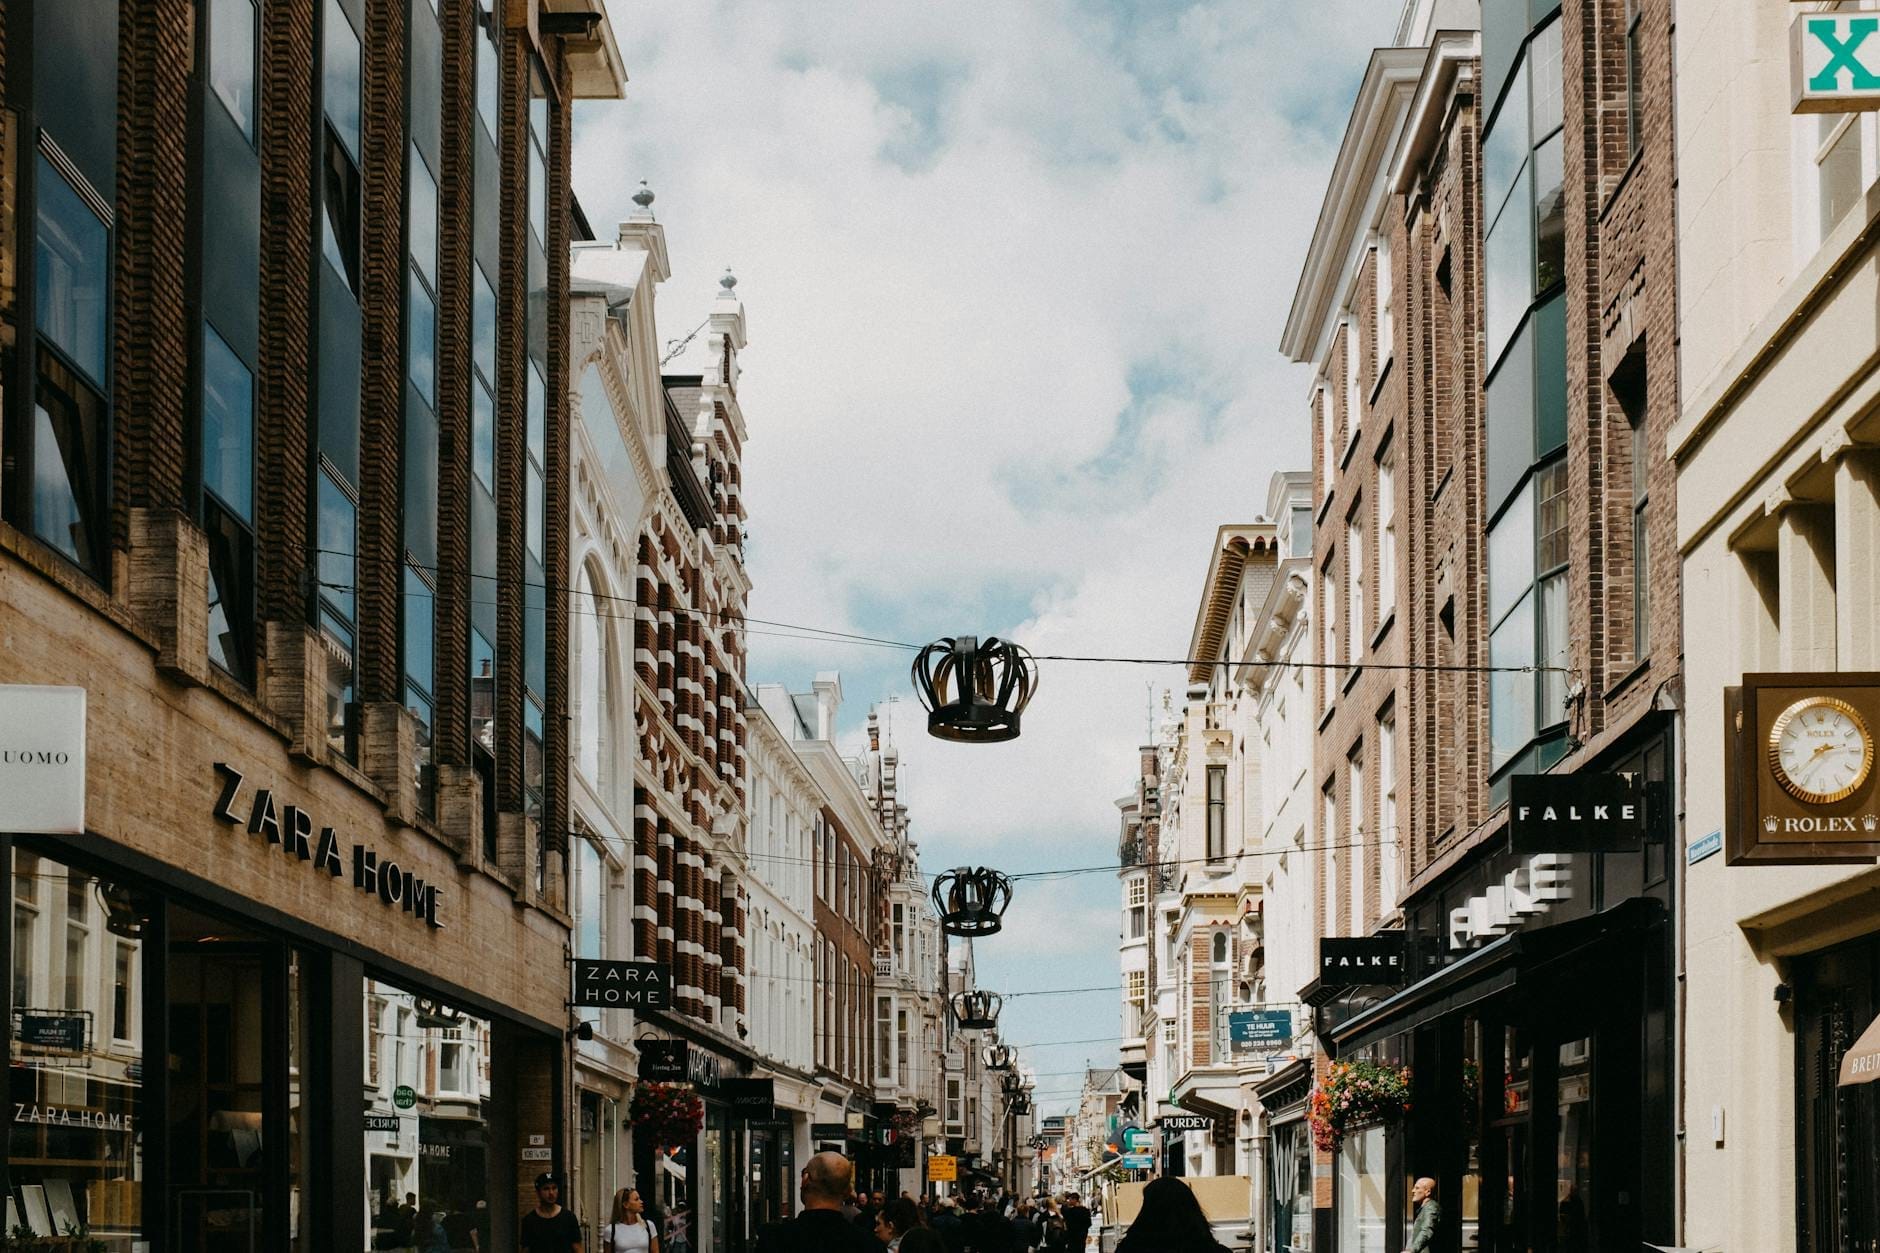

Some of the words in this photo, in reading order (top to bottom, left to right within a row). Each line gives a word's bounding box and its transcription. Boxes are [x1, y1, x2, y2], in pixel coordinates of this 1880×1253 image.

[1808, 18, 1880, 91] X
[4, 750, 68, 765] UOMO
[1519, 805, 1635, 821] FALKE
[1785, 817, 1857, 832] ROLEX
[213, 762, 343, 877] ZARA
[353, 844, 446, 929] HOME
[1324, 956, 1398, 967] FALKE
[587, 966, 660, 983] ZARA
[586, 988, 660, 1004] HOME
[15, 1103, 71, 1125] ZARA
[81, 1110, 133, 1132] HOME
[1164, 1117, 1209, 1129] PURDEY
